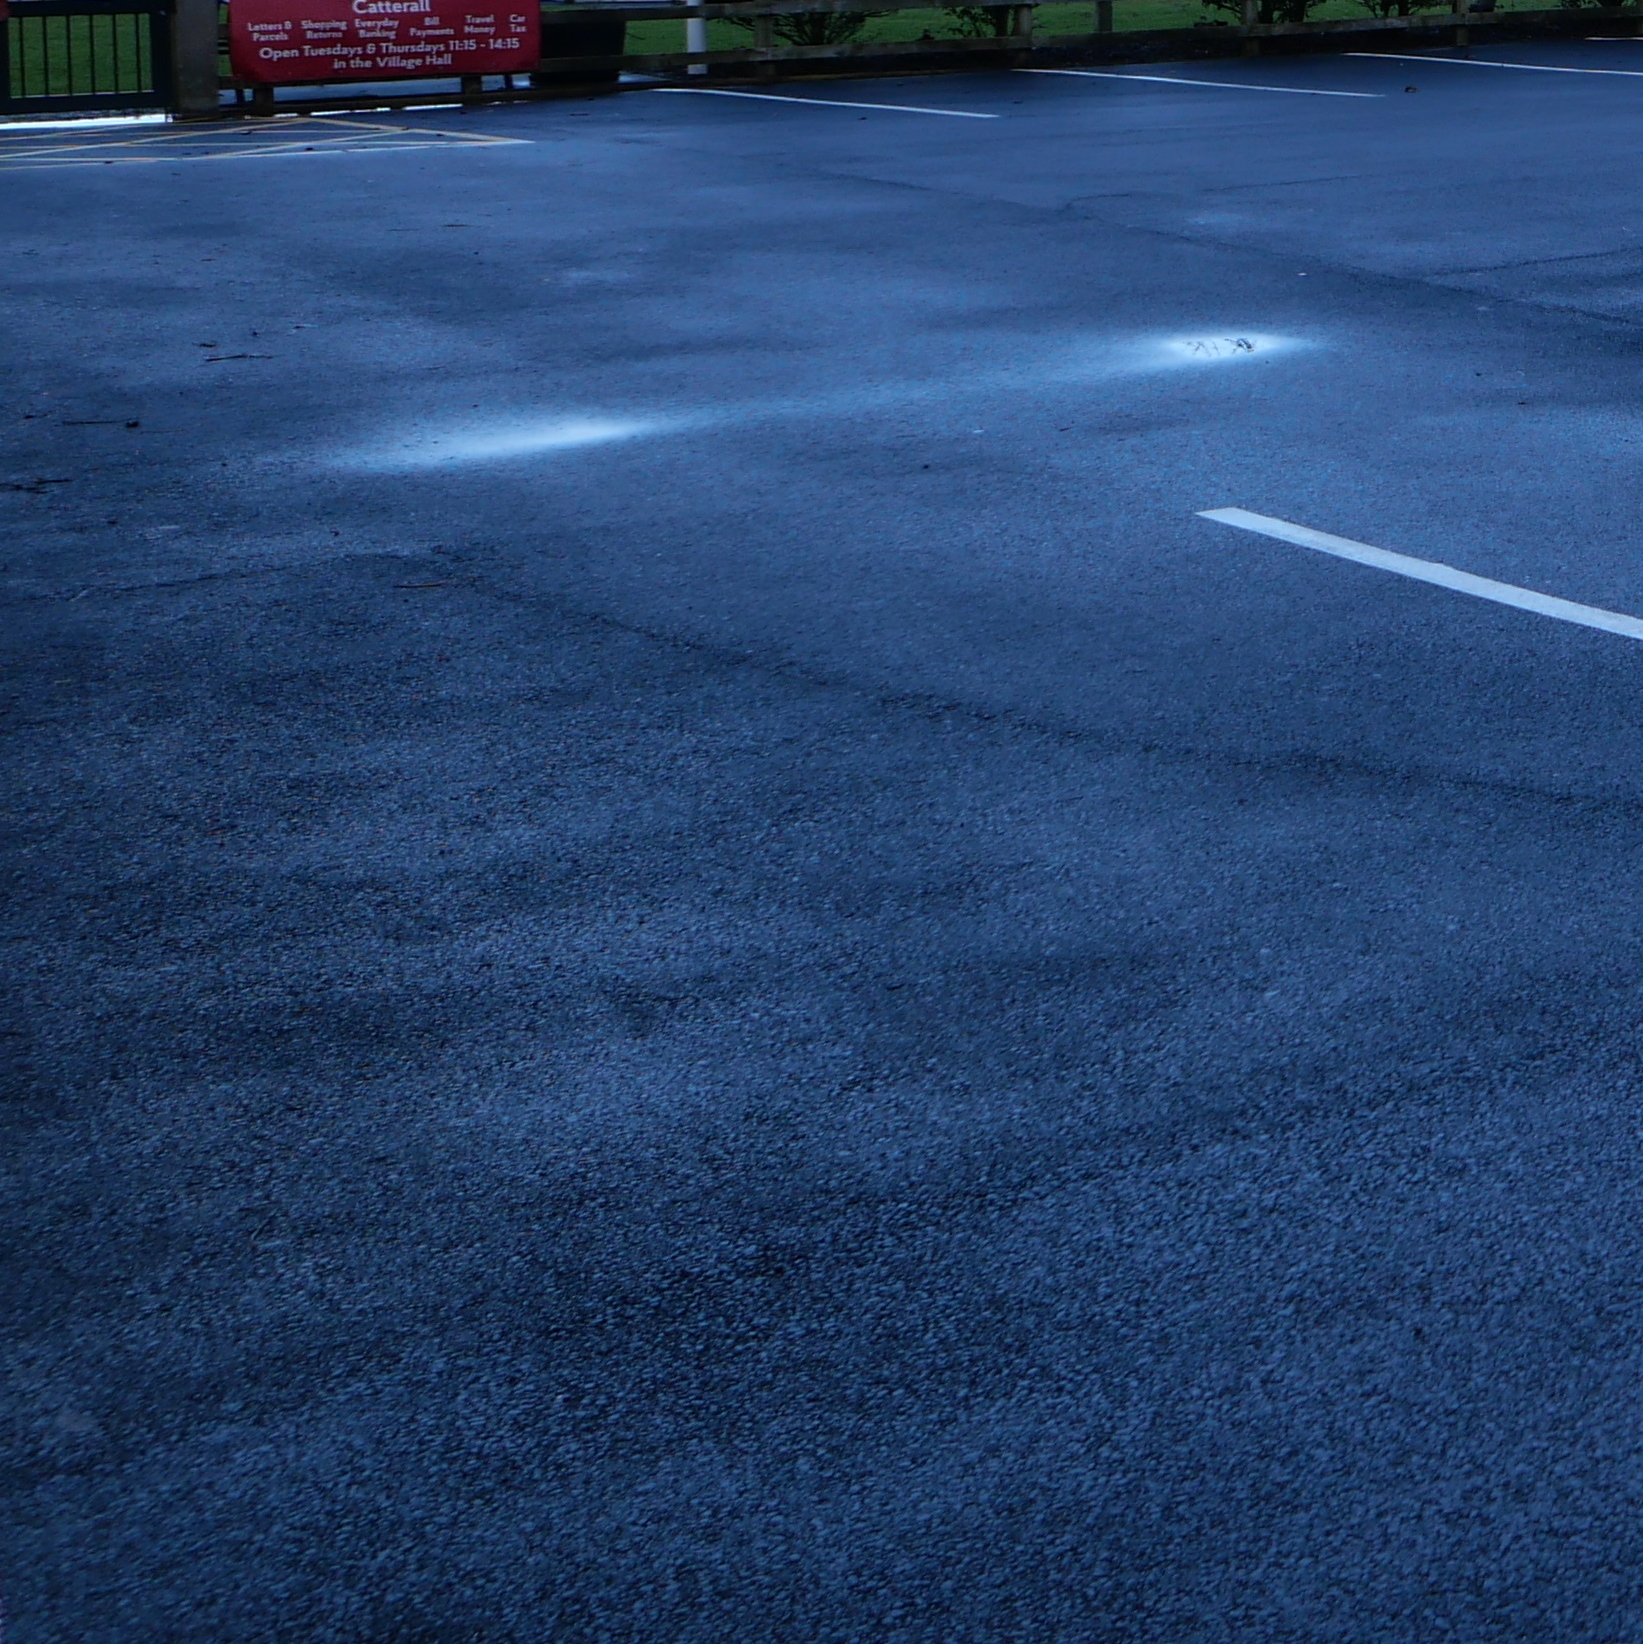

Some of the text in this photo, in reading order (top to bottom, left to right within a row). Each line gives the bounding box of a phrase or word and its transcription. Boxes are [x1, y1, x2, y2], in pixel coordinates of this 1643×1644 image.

[424, 16, 440, 26] Bill
[465, 14, 495, 23] Travel
[510, 13, 526, 23] Car
[247, 21, 292, 31] Letters &
[301, 20, 348, 31] Shopping
[355, 18, 399, 29] Everyday
[510, 24, 527, 32] Tax
[306, 31, 343, 39] Returns
[359, 29, 397, 39] Banking
[409, 27, 455, 38] Payments
[464, 25, 496, 35] Money
[253, 32, 288, 42] Parcels
[260, 47, 299, 61] Open
[303, 44, 363, 57] Tuesdays
[365, 43, 376, 54] &
[380, 41, 445, 54] Thursdays
[449, 39, 477, 50] 11:15
[489, 38, 520, 50] 14:15
[334, 54, 452, 70] in the Village Hall
